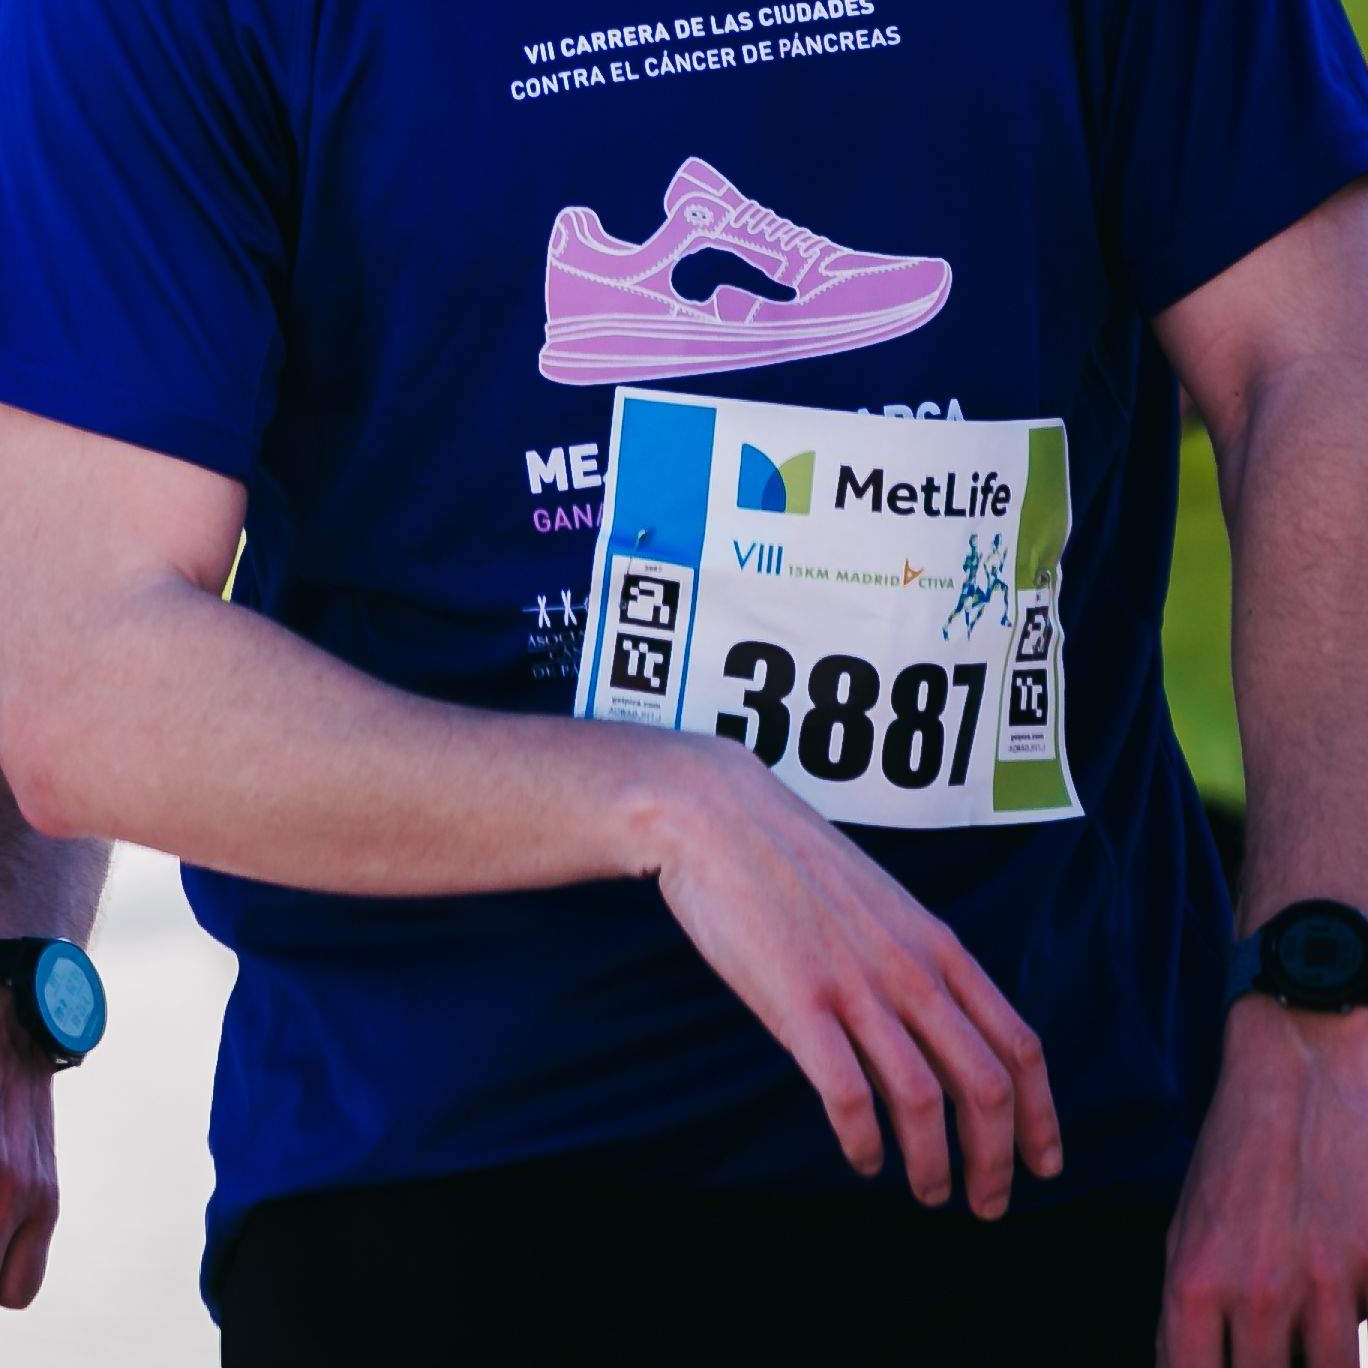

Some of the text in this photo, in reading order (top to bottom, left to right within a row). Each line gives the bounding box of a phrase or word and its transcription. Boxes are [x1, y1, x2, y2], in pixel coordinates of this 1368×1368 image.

[511, 26, 900, 100] CONTRA EL CÁNCER DE PÁNCREAS
[524, 41, 555, 64] VII
[561, 23, 670, 57] CARRERA
[675, 17, 705, 39] DE
[711, 12, 753, 34] LAS
[525, 443, 606, 494] ME
[835, 466, 1010, 517] MetLife
[733, 539, 784, 576] VIII
[788, 563, 830, 581] 15KM
[835, 569, 901, 589] MADRID
[715, 640, 988, 790] 3887
